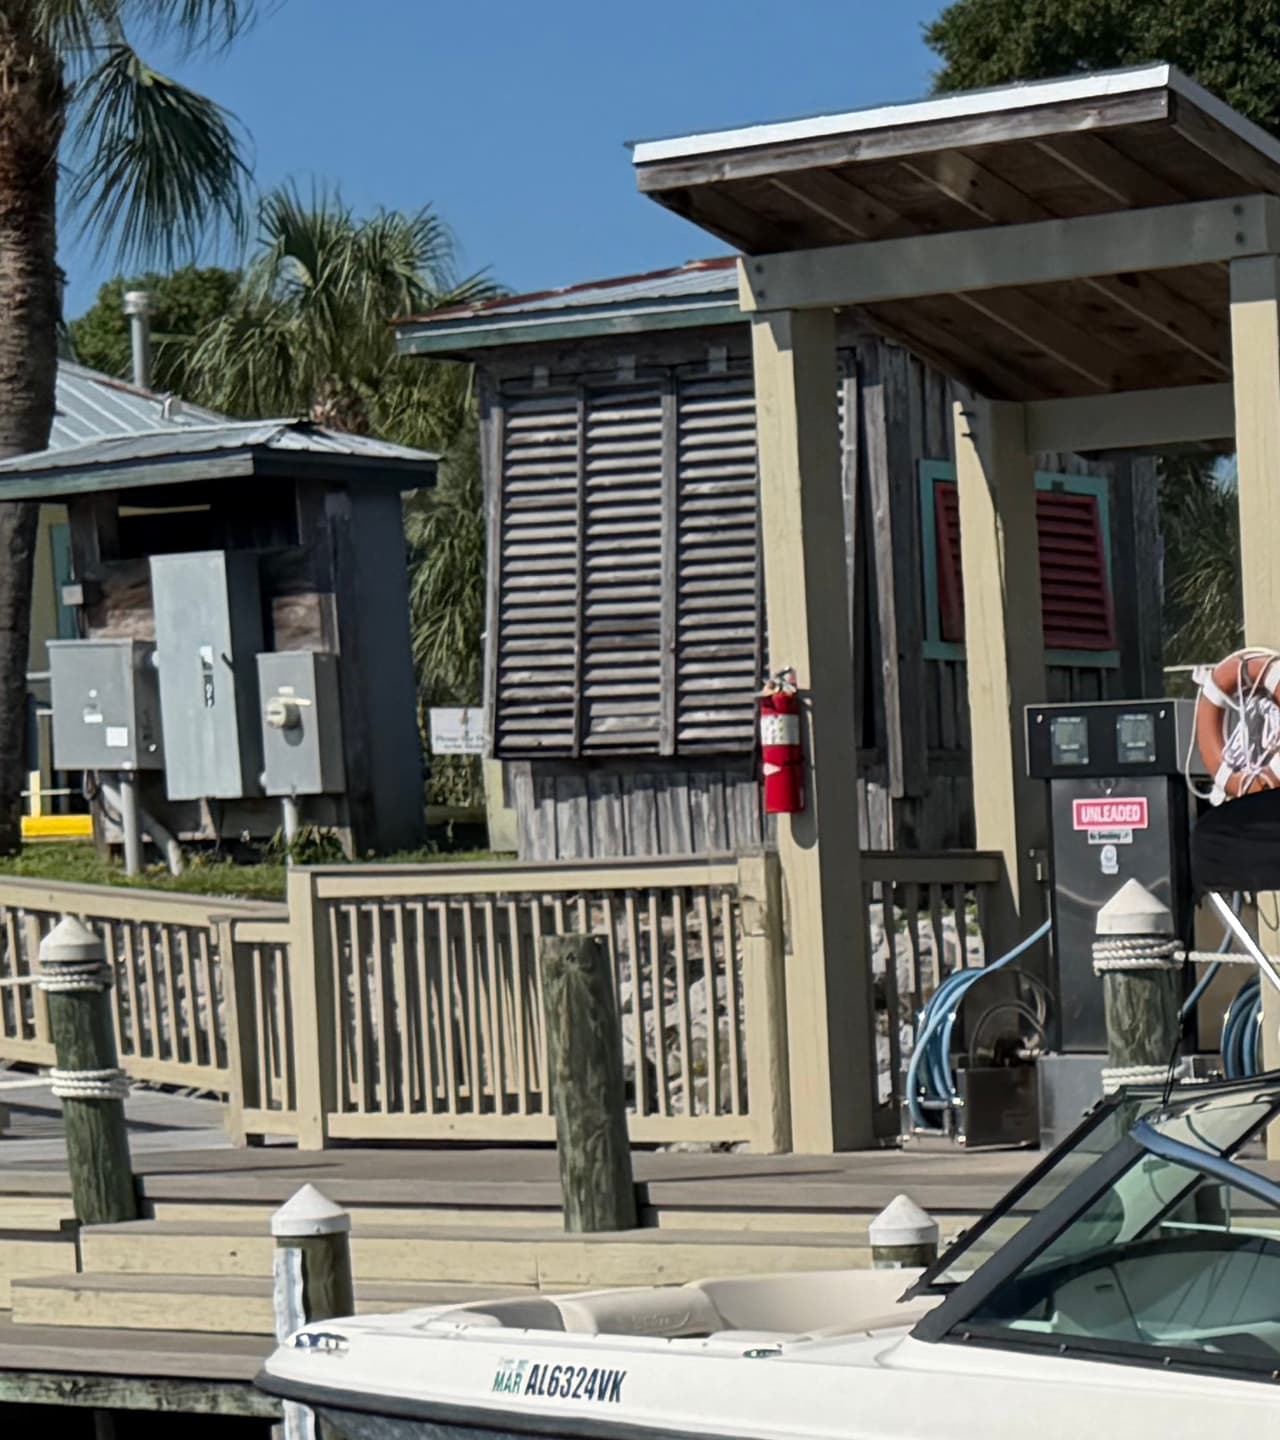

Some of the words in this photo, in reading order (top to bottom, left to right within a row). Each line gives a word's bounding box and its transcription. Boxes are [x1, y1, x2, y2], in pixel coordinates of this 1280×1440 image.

[1081, 804, 1141, 823] UNLEADED
[492, 1370, 523, 1394] MAR
[525, 1363, 627, 1403] AL6324VK
